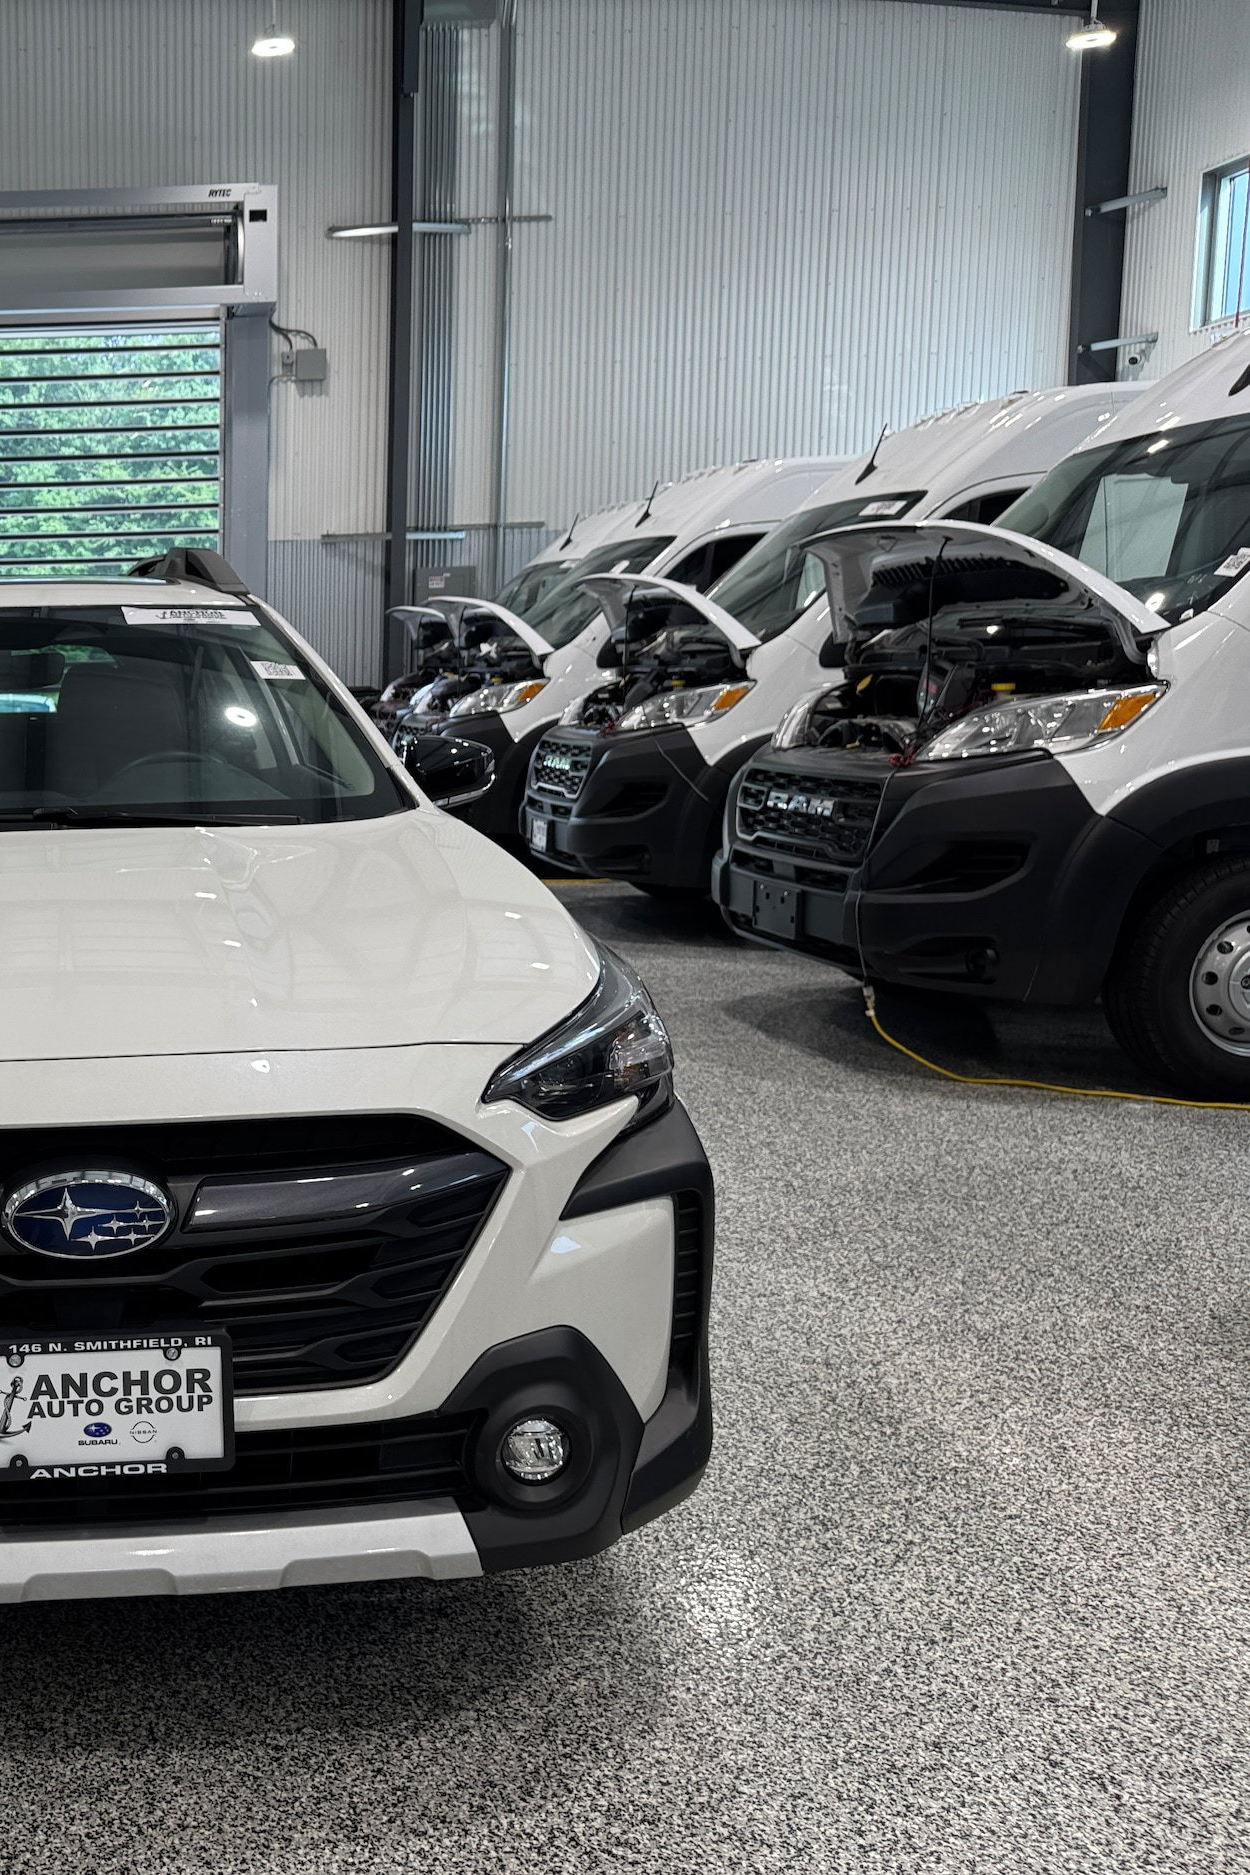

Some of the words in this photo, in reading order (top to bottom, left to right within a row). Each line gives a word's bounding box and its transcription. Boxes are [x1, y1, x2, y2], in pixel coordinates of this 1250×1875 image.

[208, 189, 231, 197] RYTEC
[767, 791, 835, 817] RAM
[9, 1343, 42, 1354] 146
[49, 1342, 67, 1352] N.
[74, 1337, 188, 1351] SMITHFIELD,
[195, 1336, 212, 1346] RI
[29, 1368, 213, 1401] ANCHOR
[27, 1398, 104, 1419] AUTO
[114, 1394, 213, 1416] GROUP
[29, 1463, 168, 1480] ANCHOR
